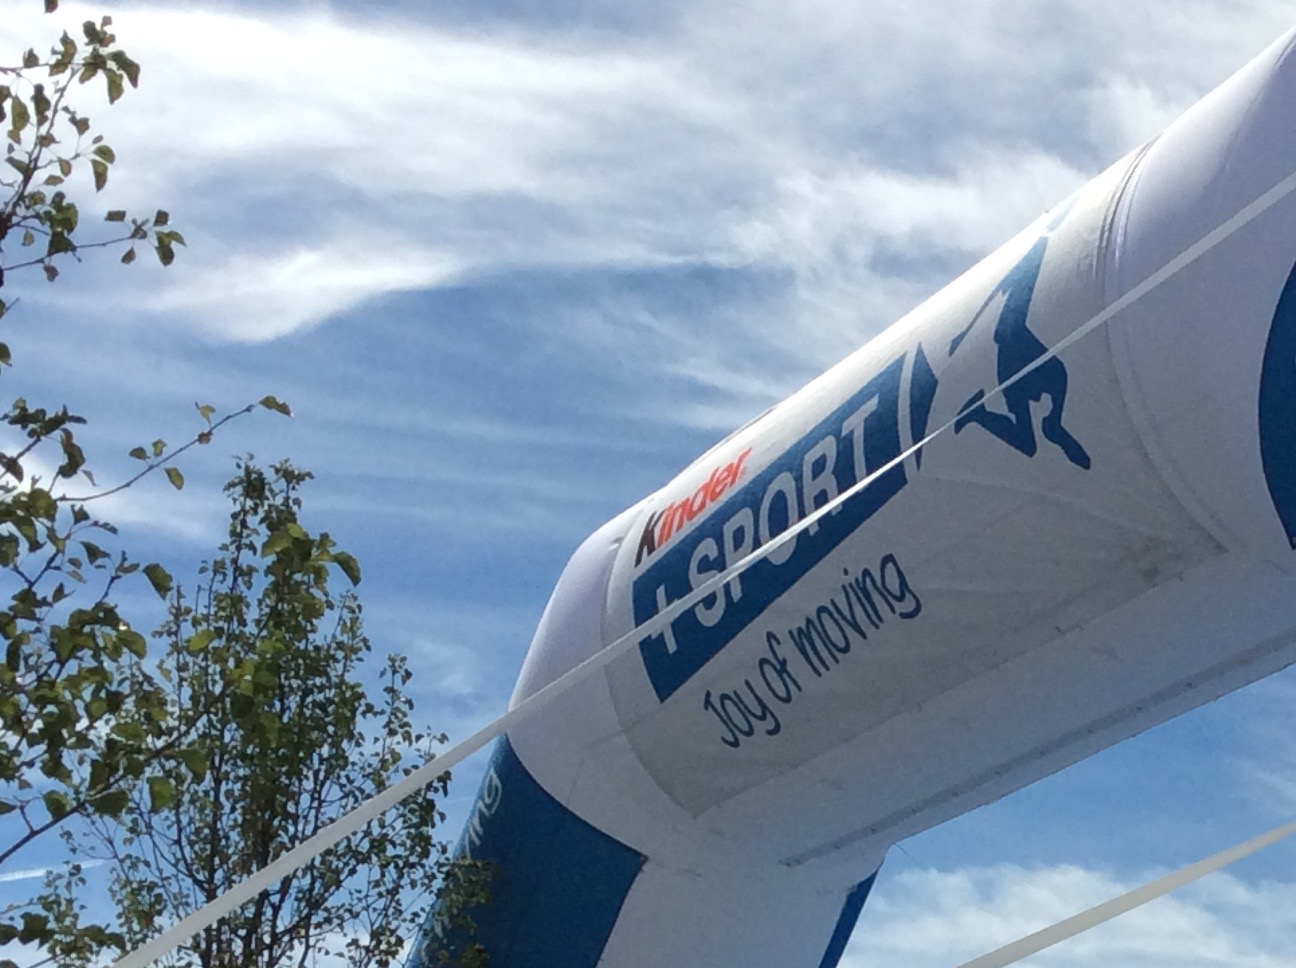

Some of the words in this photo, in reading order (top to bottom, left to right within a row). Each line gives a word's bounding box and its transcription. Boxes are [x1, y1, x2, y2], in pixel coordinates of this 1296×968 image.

[704, 680, 782, 748] Joy
[759, 631, 802, 703] of
[788, 554, 922, 678] moving
